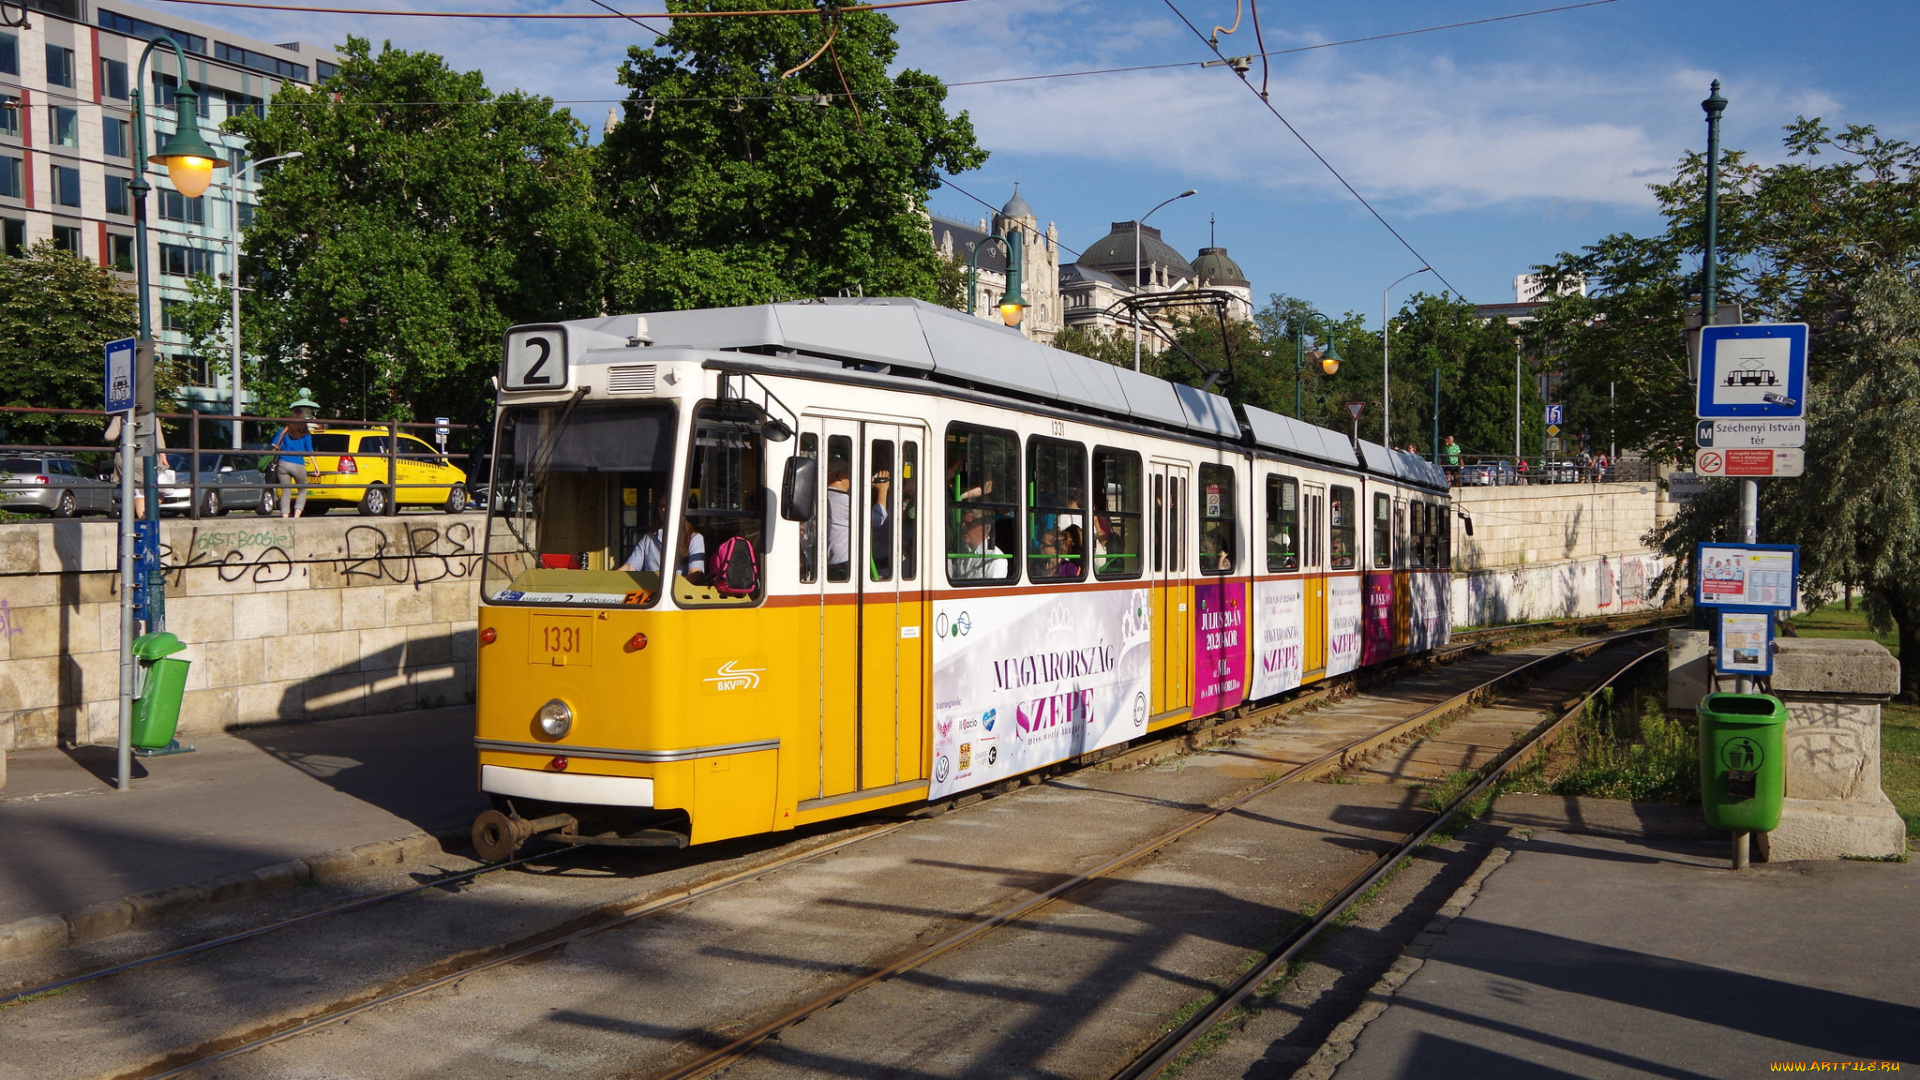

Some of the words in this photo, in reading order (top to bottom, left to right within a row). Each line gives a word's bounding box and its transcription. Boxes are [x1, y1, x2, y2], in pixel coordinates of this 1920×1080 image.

[523, 336, 551, 385] 2
[1051, 419, 1065, 437] 1331
[1700, 428, 1712, 440] M
[1716, 423, 1766, 435] Széchenyi
[1769, 422, 1800, 433] István
[1750, 435, 1766, 445] tér
[543, 626, 580, 653] 1331
[993, 638, 1115, 692] MAGYARORSZÁG
[717, 681, 736, 691] BKV
[1015, 683, 1094, 742] SZÉPE
